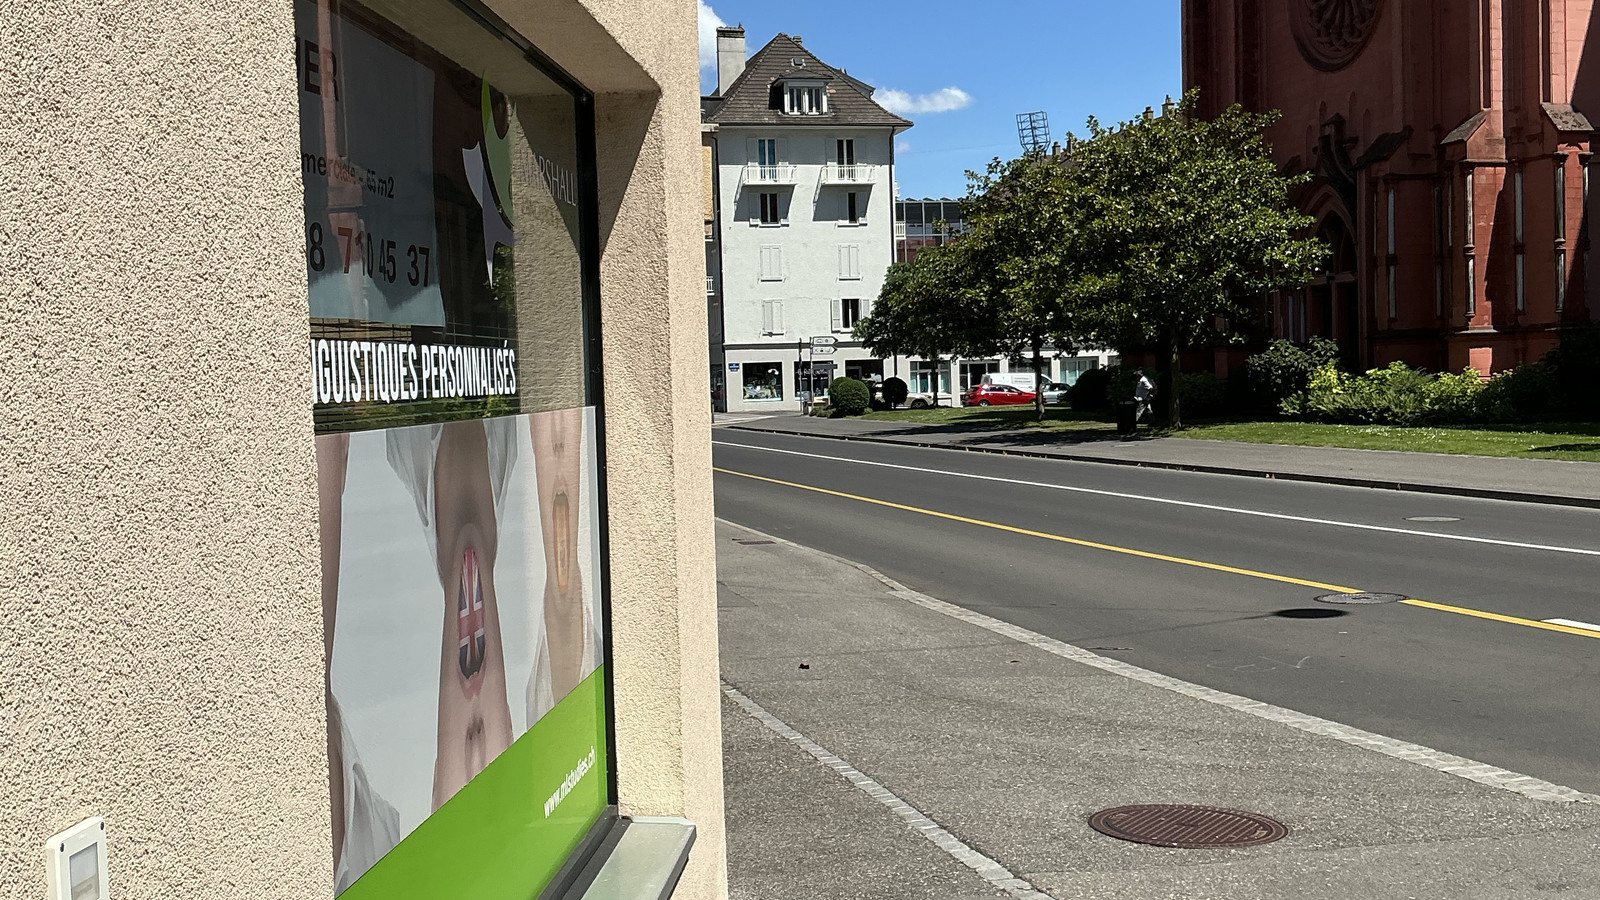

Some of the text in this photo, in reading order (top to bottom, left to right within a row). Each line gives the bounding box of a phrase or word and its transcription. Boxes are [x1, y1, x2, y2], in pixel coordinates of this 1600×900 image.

[296, 36, 339, 102] ER
[378, 175, 395, 199] m2
[379, 238, 396, 283] 45
[407, 244, 430, 287] 37
[421, 339, 516, 399] PERSONNALISÉS
[543, 745, 595, 819] www.mlstudies.ch
